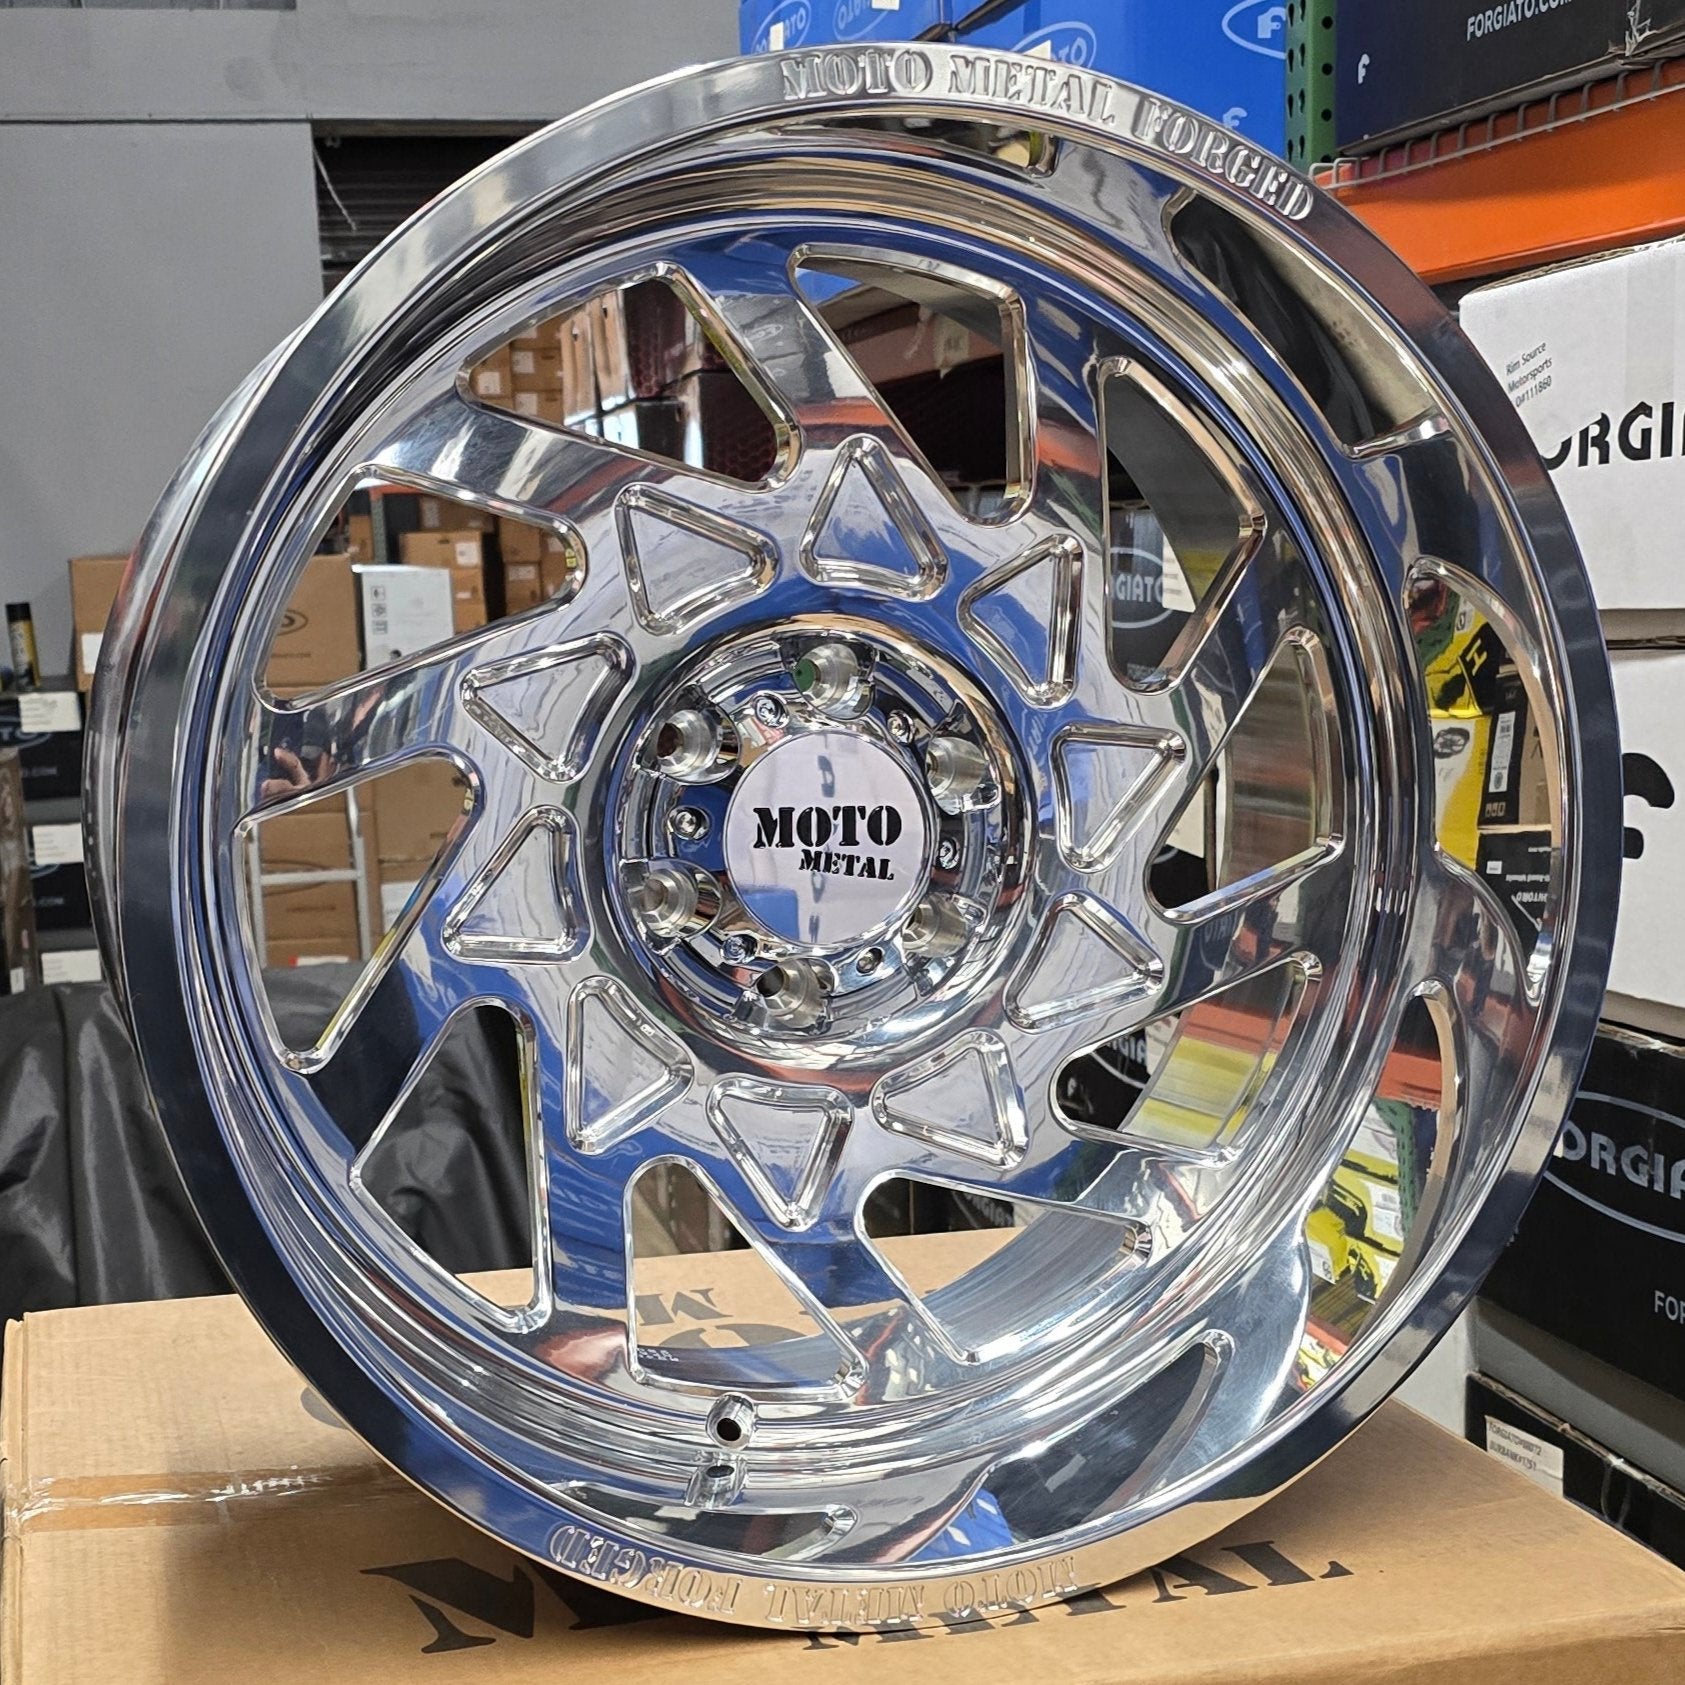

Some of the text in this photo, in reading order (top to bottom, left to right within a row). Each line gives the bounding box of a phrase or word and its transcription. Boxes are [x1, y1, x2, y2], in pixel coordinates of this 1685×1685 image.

[780, 50, 1314, 221] MOTO METAL FORGED
[1508, 357, 1552, 393] Motorsports
[1521, 342, 1546, 366] Source
[753, 805, 902, 849] MOTO
[799, 849, 894, 881] METAL
[550, 1524, 743, 1614] FORGED
[943, 1555, 1080, 1617] MOTO
[763, 1582, 924, 1625] METAL
